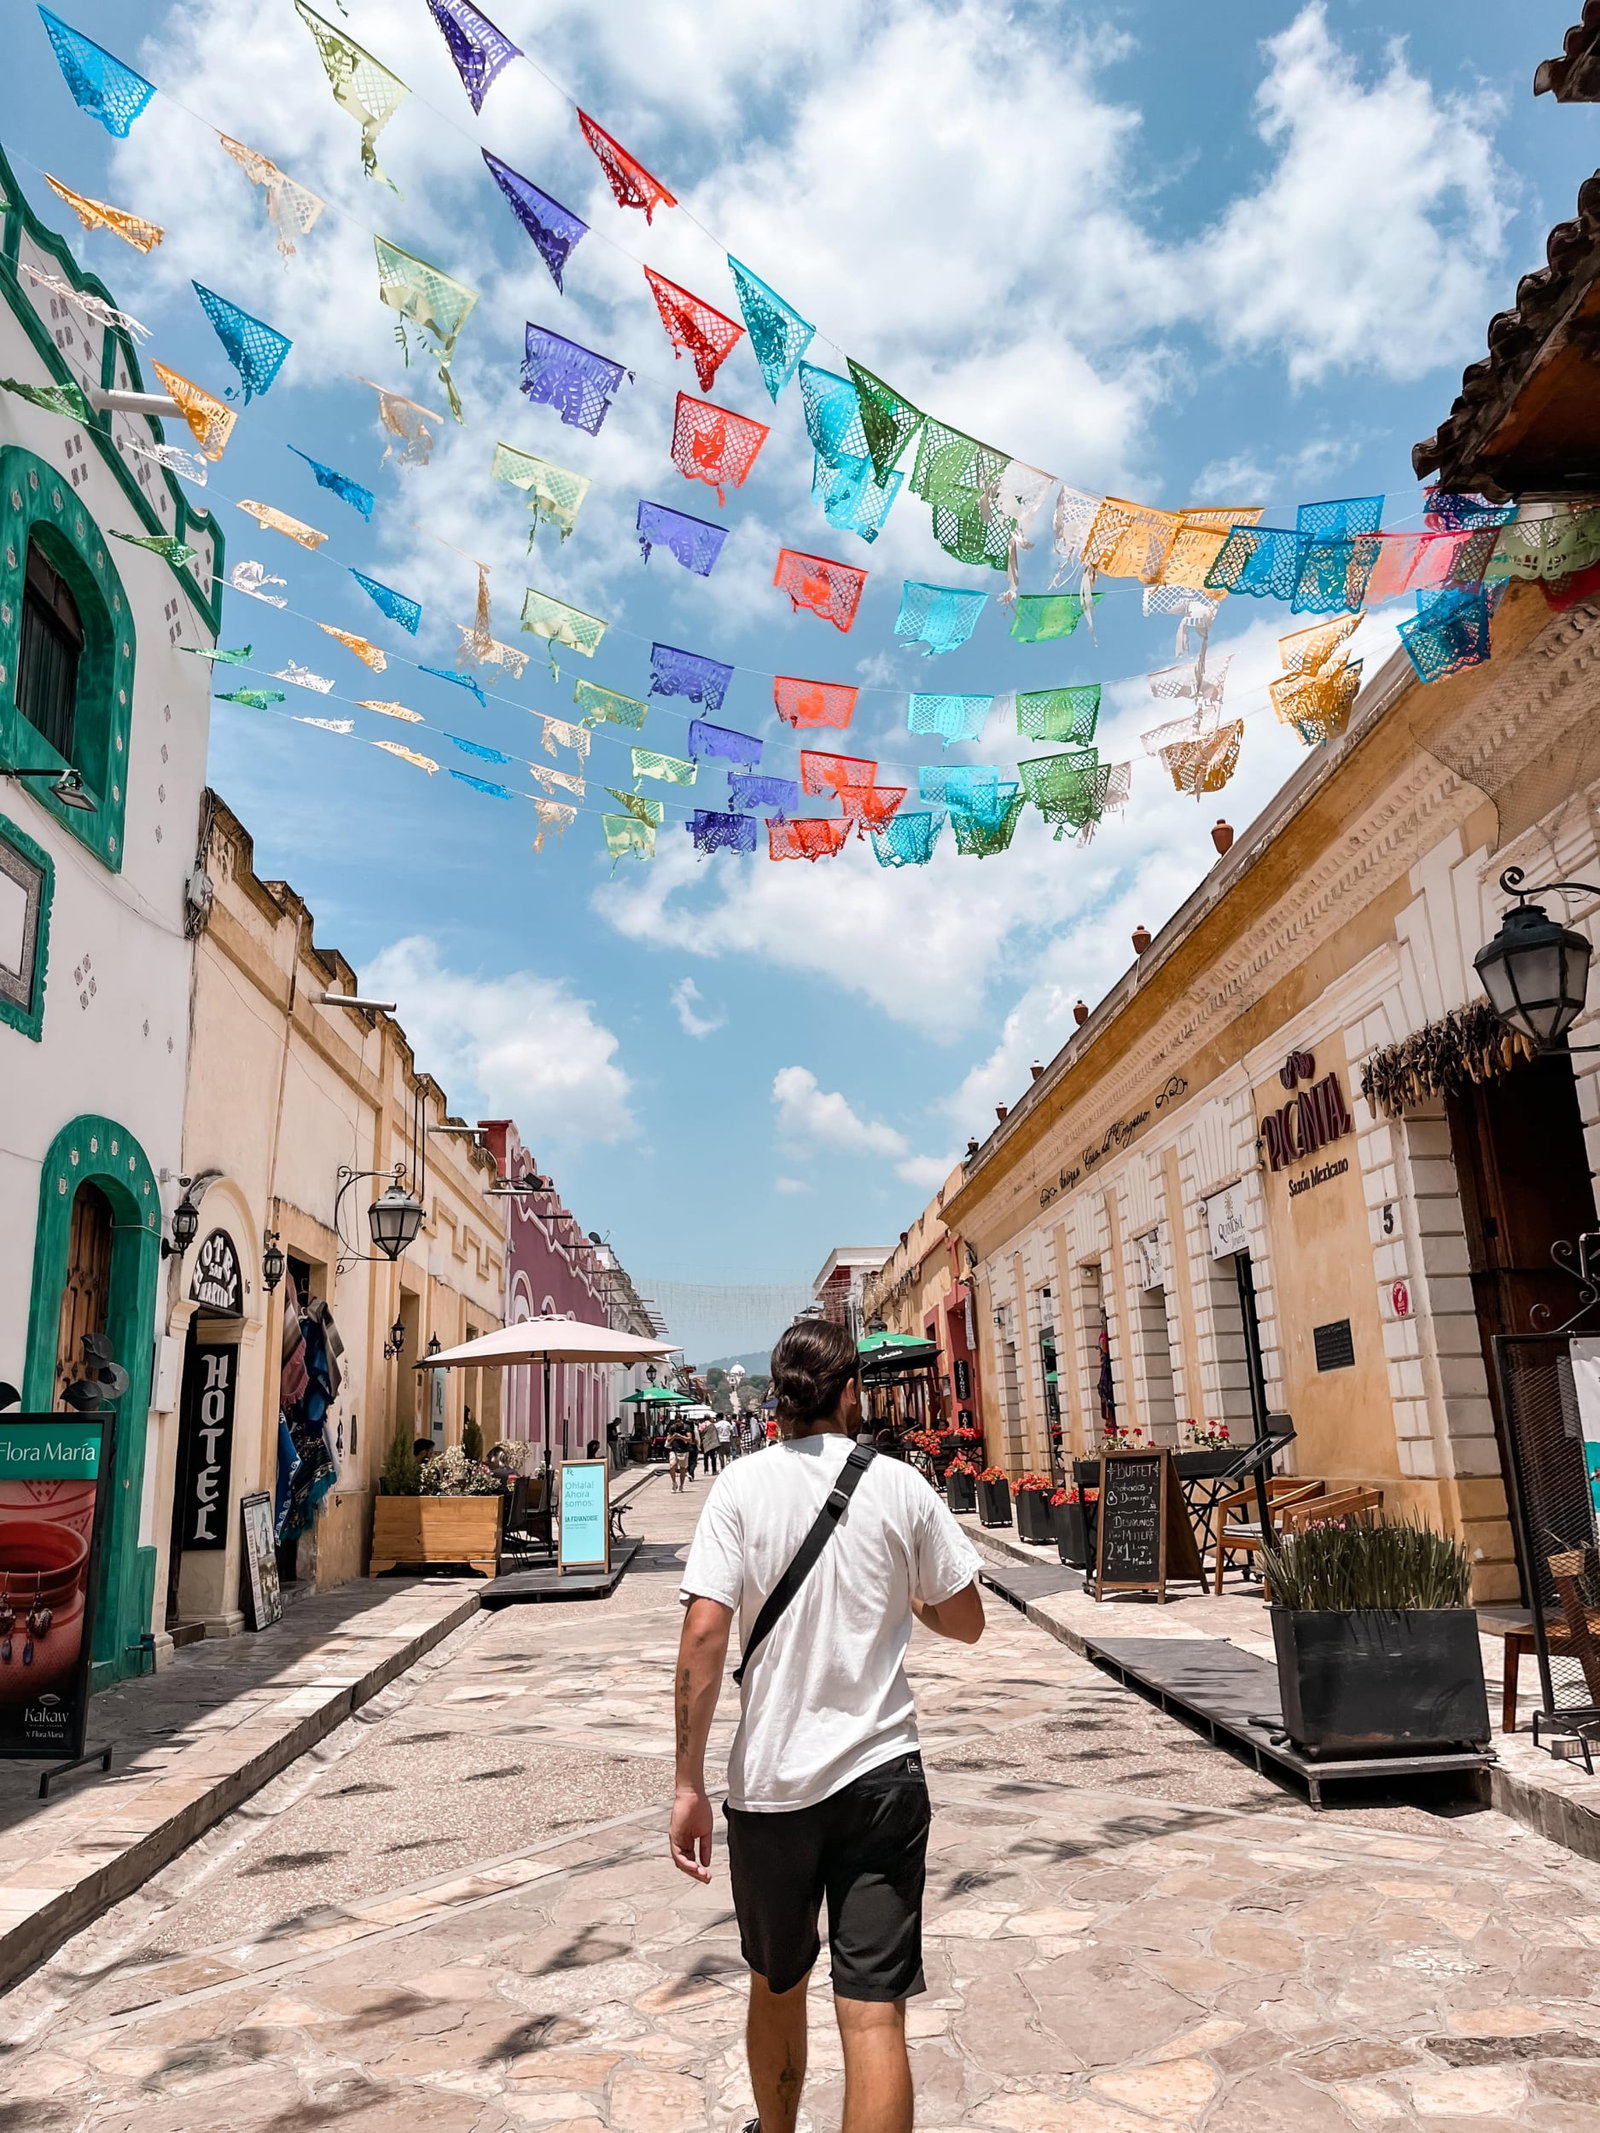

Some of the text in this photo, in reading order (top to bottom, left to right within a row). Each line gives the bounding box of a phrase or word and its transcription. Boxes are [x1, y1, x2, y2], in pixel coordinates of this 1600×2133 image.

[1261, 1072, 1351, 1172] PICANTA
[1310, 1158, 1349, 1188] Mexicano
[1383, 1203, 1394, 1234] 5
[44, 1442, 96, 1461] María
[193, 1354, 229, 1540] HOTEL
[1115, 1463, 1153, 1479] BUFFET
[24, 1707, 70, 1723] Kakaw
